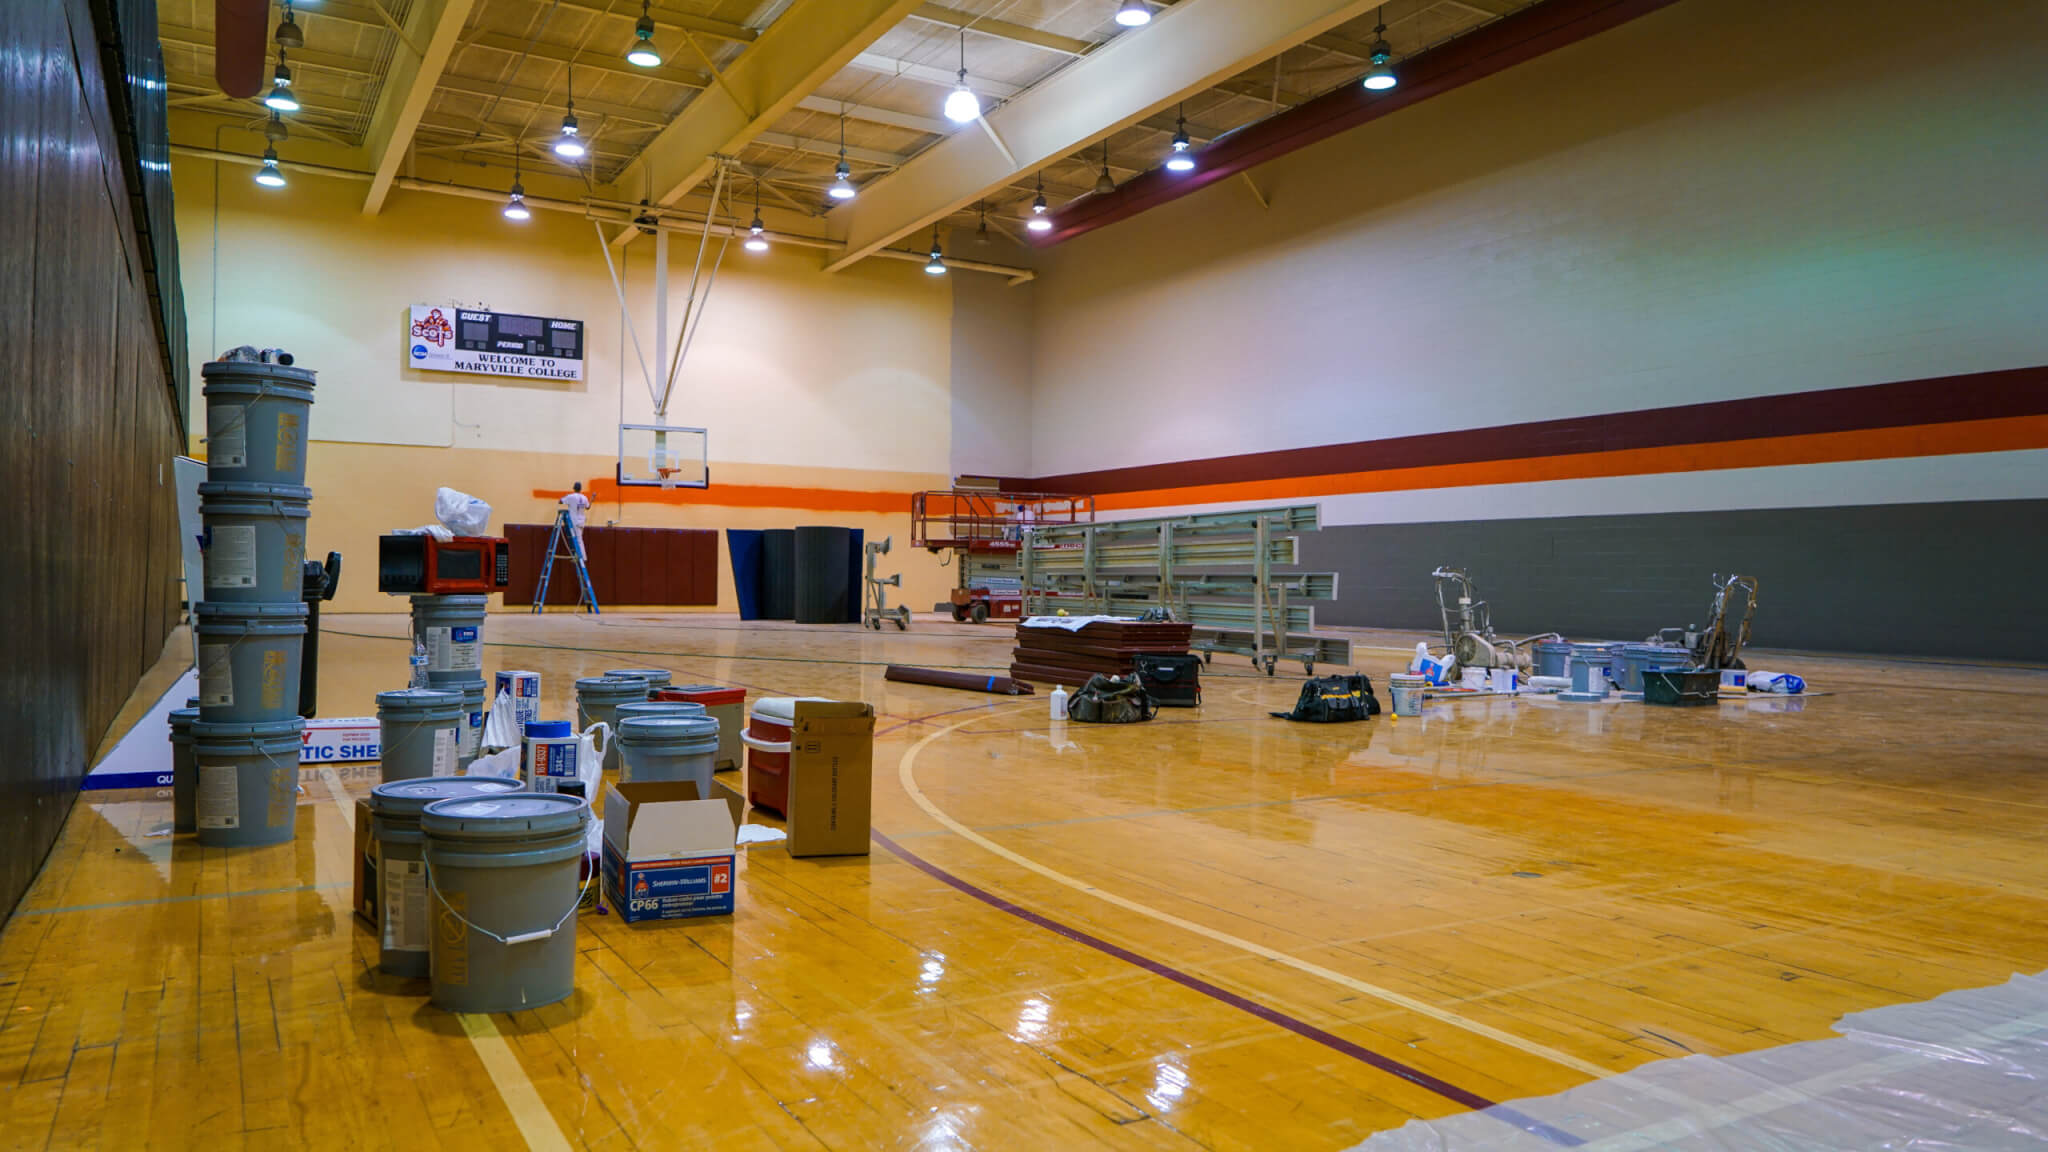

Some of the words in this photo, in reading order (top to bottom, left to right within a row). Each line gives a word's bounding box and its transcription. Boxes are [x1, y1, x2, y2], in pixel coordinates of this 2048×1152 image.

[460, 312, 492, 322] GUEST
[551, 321, 577, 330] HOME
[478, 353, 536, 366] WELCOME
[539, 359, 556, 368] TO
[454, 361, 524, 374] MARYVILLE
[528, 368, 577, 379] COLLEGE
[299, 745, 334, 759] TIC
[156, 775, 174, 785] QU
[713, 873, 728, 885] #2
[630, 899, 659, 912] CP66
